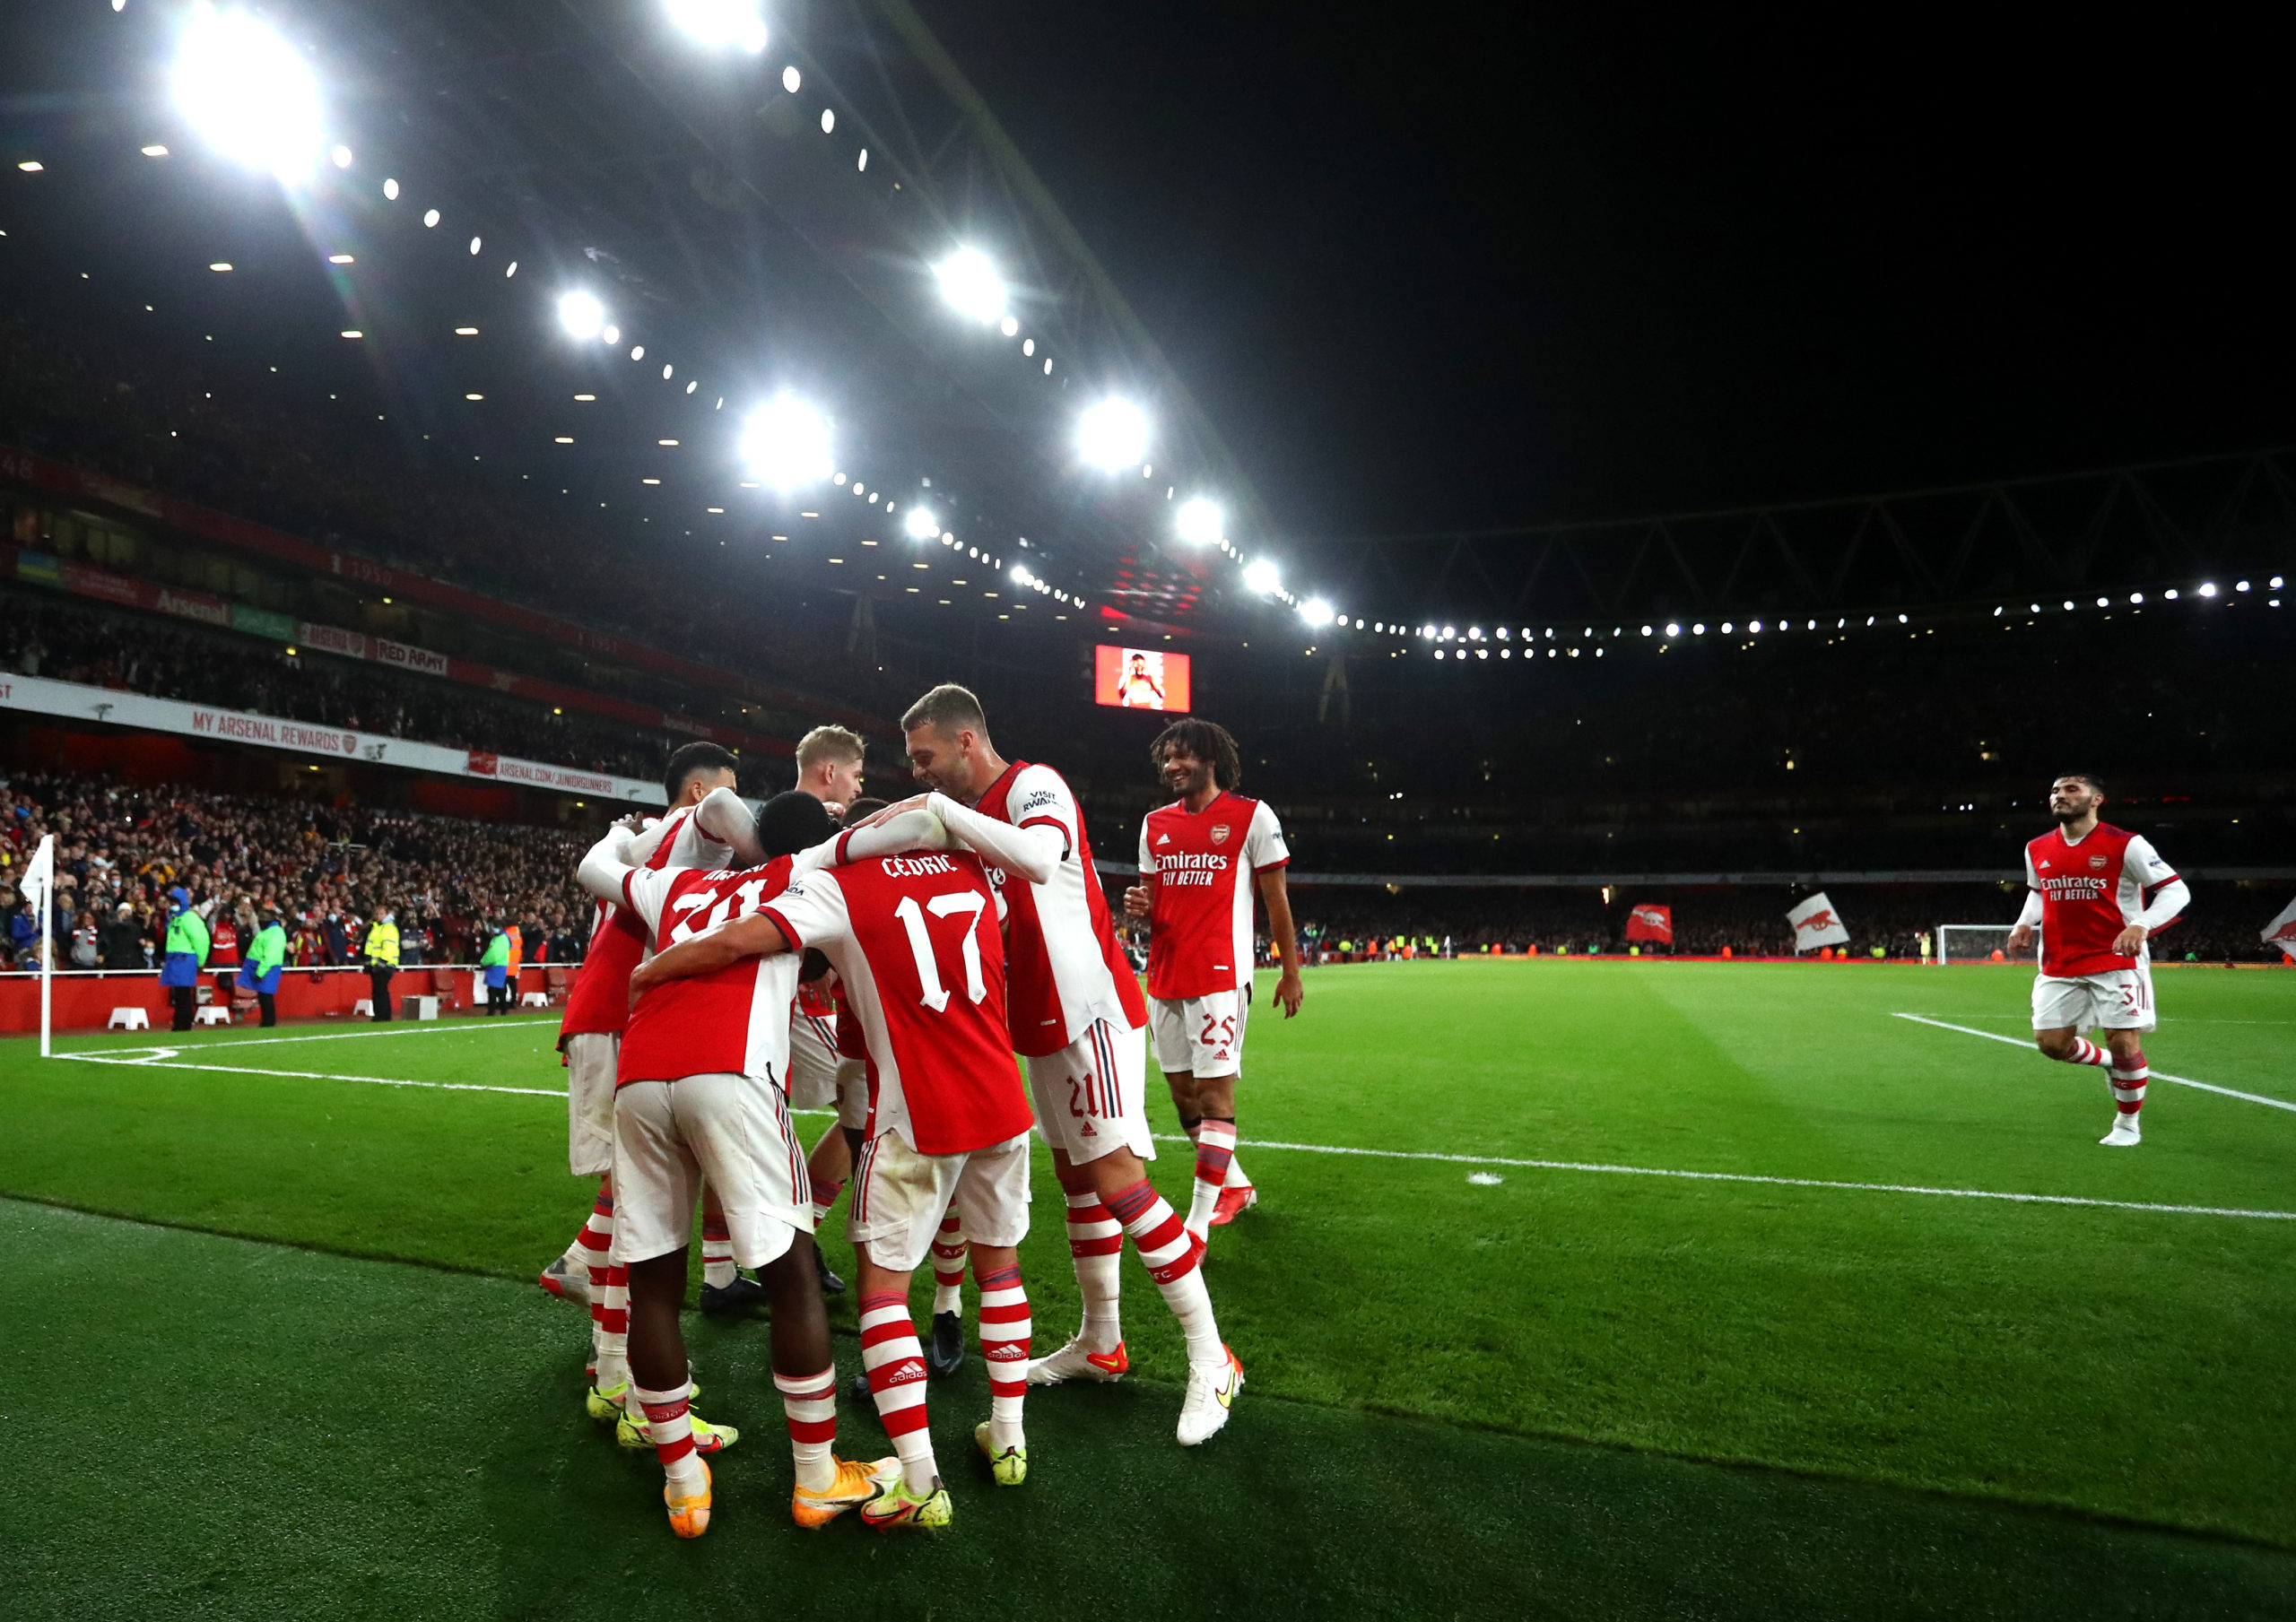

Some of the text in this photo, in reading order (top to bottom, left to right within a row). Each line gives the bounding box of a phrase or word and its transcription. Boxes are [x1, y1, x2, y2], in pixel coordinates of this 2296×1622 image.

[157, 588, 230, 627] Arsenal
[378, 642, 444, 672] RED ARMY
[193, 711, 340, 751] MY ARSENAL REWARDS
[1031, 791, 1056, 800] VISIT
[1156, 851, 1228, 872] Emirates
[1162, 870, 1214, 887] FLY BETTER
[2040, 875, 2107, 890] Emirates
[2049, 889, 2099, 902] FLY BETTER
[894, 889, 987, 1013] 17
[1201, 1013, 1236, 1047] 25
[1066, 1072, 1100, 1118] 21
[987, 1351, 1027, 1360] adidas
[889, 1370, 927, 1383] adidas
